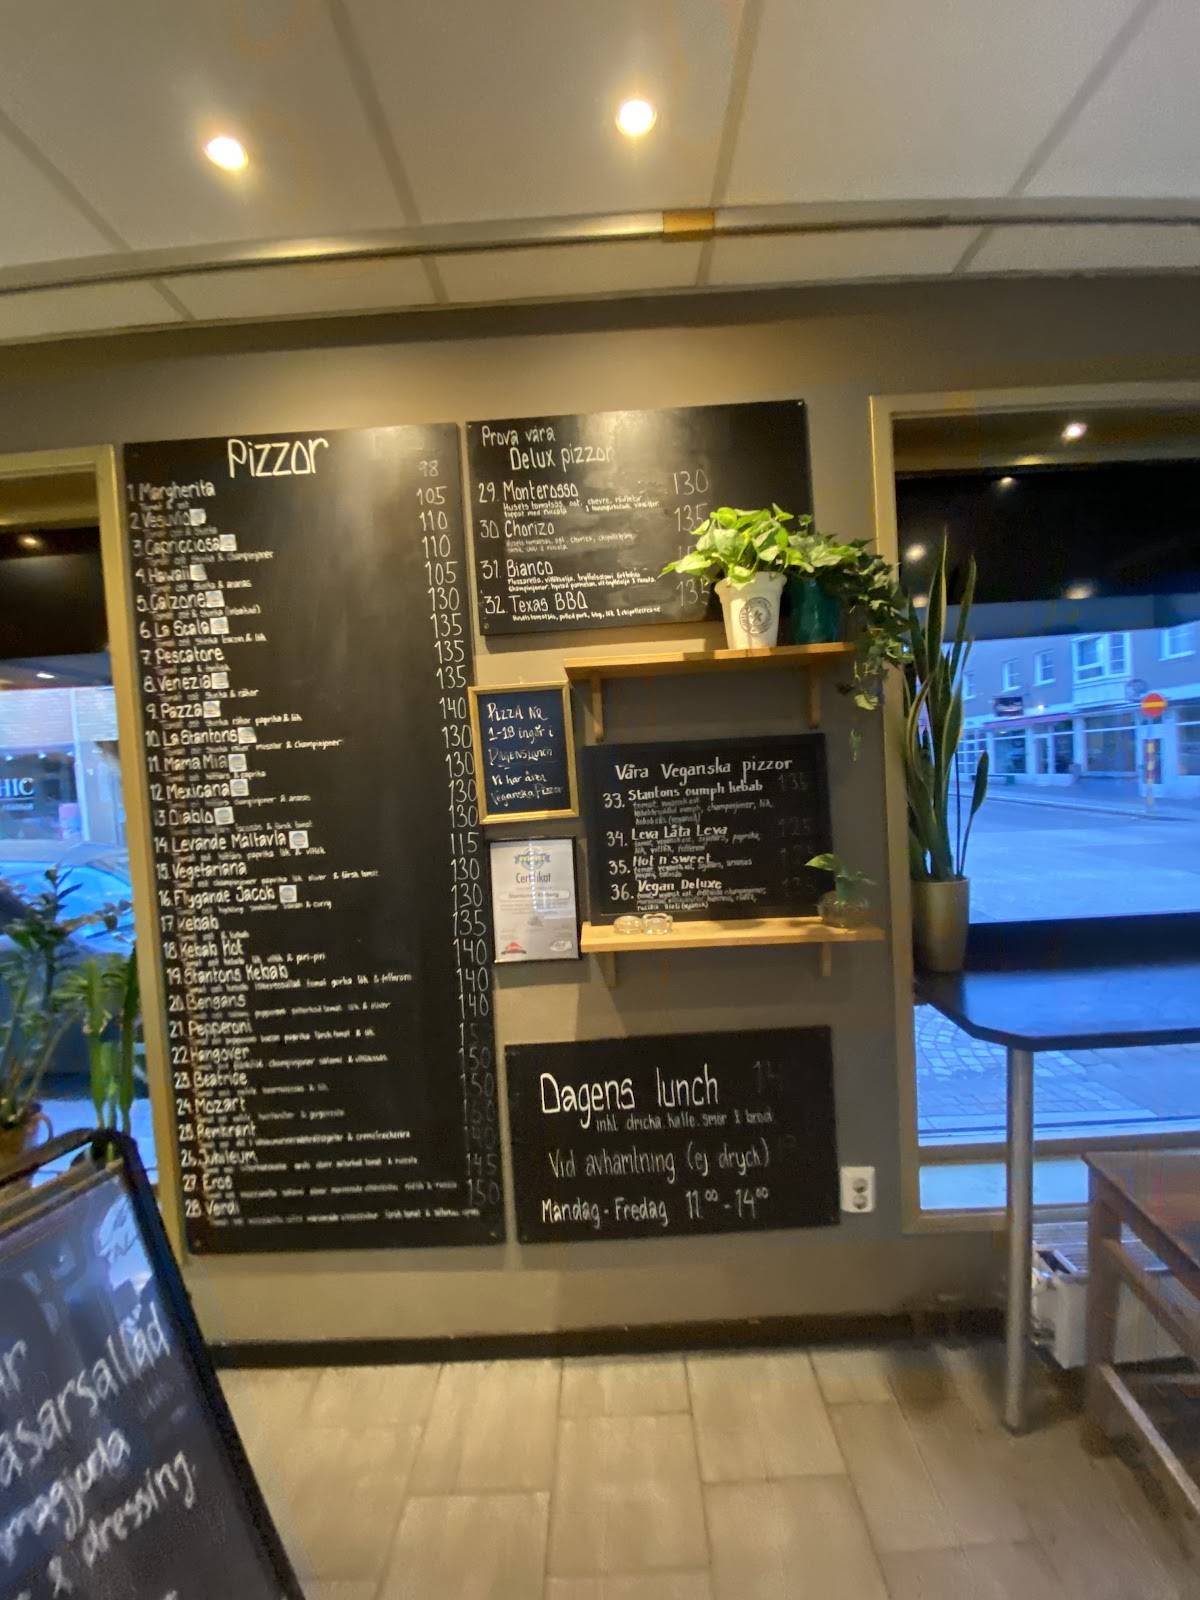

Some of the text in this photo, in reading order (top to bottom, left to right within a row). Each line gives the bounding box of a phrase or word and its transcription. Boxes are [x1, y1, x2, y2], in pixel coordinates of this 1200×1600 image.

[482, 425, 519, 447] Prova
[227, 438, 329, 478] Pizzor
[510, 447, 556, 471] Delux
[503, 480, 579, 501] Monterosso
[673, 469, 709, 495] 130
[416, 486, 448, 505] 105
[419, 510, 449, 532] 110
[505, 520, 555, 538] Chorizo
[421, 534, 451, 559] 110
[424, 561, 458, 586] 105
[507, 559, 553, 577] Bianco
[427, 587, 460, 611] 130
[508, 595, 548, 614] Texas
[555, 591, 588, 610] BBQ
[430, 613, 463, 639] 135
[155, 646, 225, 665] Pescatore
[434, 640, 465, 664] 135
[157, 673, 213, 693] Venezia
[436, 665, 467, 689] 135
[439, 697, 467, 719] 140
[441, 724, 473, 749] 130
[164, 756, 201, 771] Mama
[203, 754, 228, 770] Mia
[445, 751, 475, 778] 130
[661, 757, 731, 787] Veganska
[742, 756, 793, 783] pizzor
[166, 782, 231, 799] Mexicana
[448, 779, 477, 804] 130
[506, 774, 523, 785] har
[628, 785, 680, 801] Stantons
[685, 783, 725, 801] oumph
[168, 808, 215, 825] Diablo
[449, 805, 478, 829] 130
[171, 833, 227, 851] Levande
[450, 832, 480, 855] 115
[172, 861, 248, 881] Vegetariana
[450, 857, 480, 882] 130
[235, 885, 276, 902] Jacob
[450, 882, 483, 911] 130
[638, 879, 675, 897] Vegan
[681, 878, 722, 890] Deluxe
[452, 909, 487, 937] 135
[452, 938, 488, 967] 140
[245, 964, 289, 981] Kebab
[456, 967, 489, 993] 140
[458, 993, 489, 1019] 140
[187, 1019, 253, 1038] Pepperoni
[540, 1072, 635, 1129] Dagens
[656, 1063, 719, 1107] lunch
[549, 1148, 576, 1178] Vid
[614, 1196, 668, 1228] Fredag
